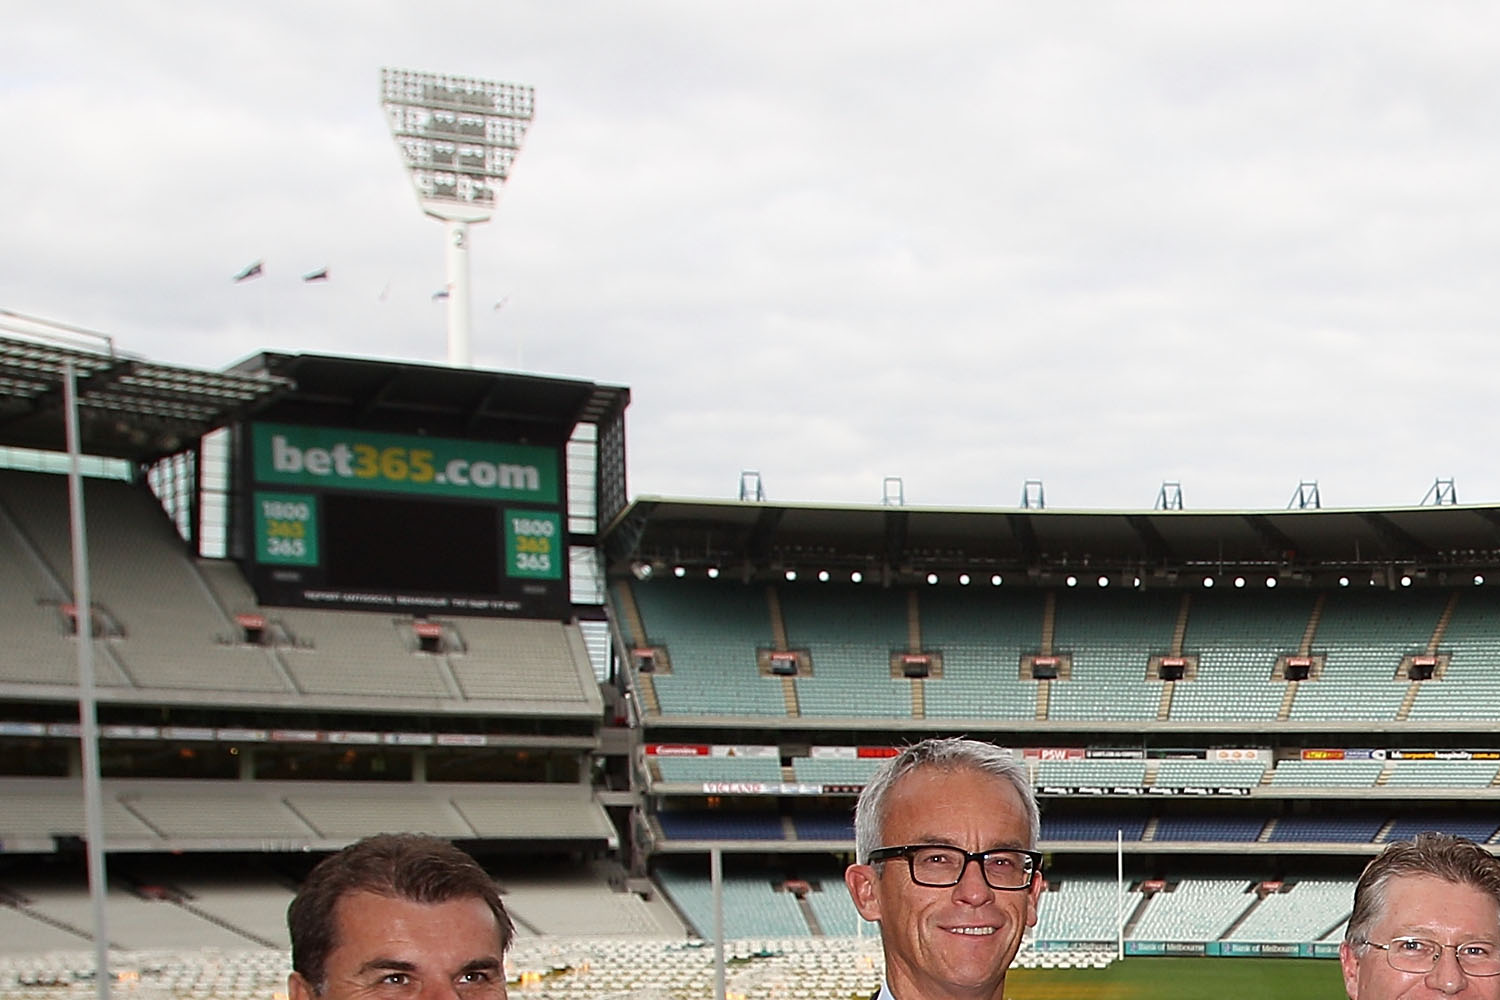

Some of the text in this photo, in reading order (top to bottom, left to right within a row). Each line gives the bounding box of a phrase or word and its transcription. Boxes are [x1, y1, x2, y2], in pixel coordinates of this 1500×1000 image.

[271, 434, 541, 491] bet365.com
[262, 500, 310, 520] 1800
[267, 520, 305, 538] 365
[512, 517, 554, 536] 1800
[267, 537, 306, 557] 365
[516, 536, 550, 554] 365
[516, 553, 550, 571] 365
